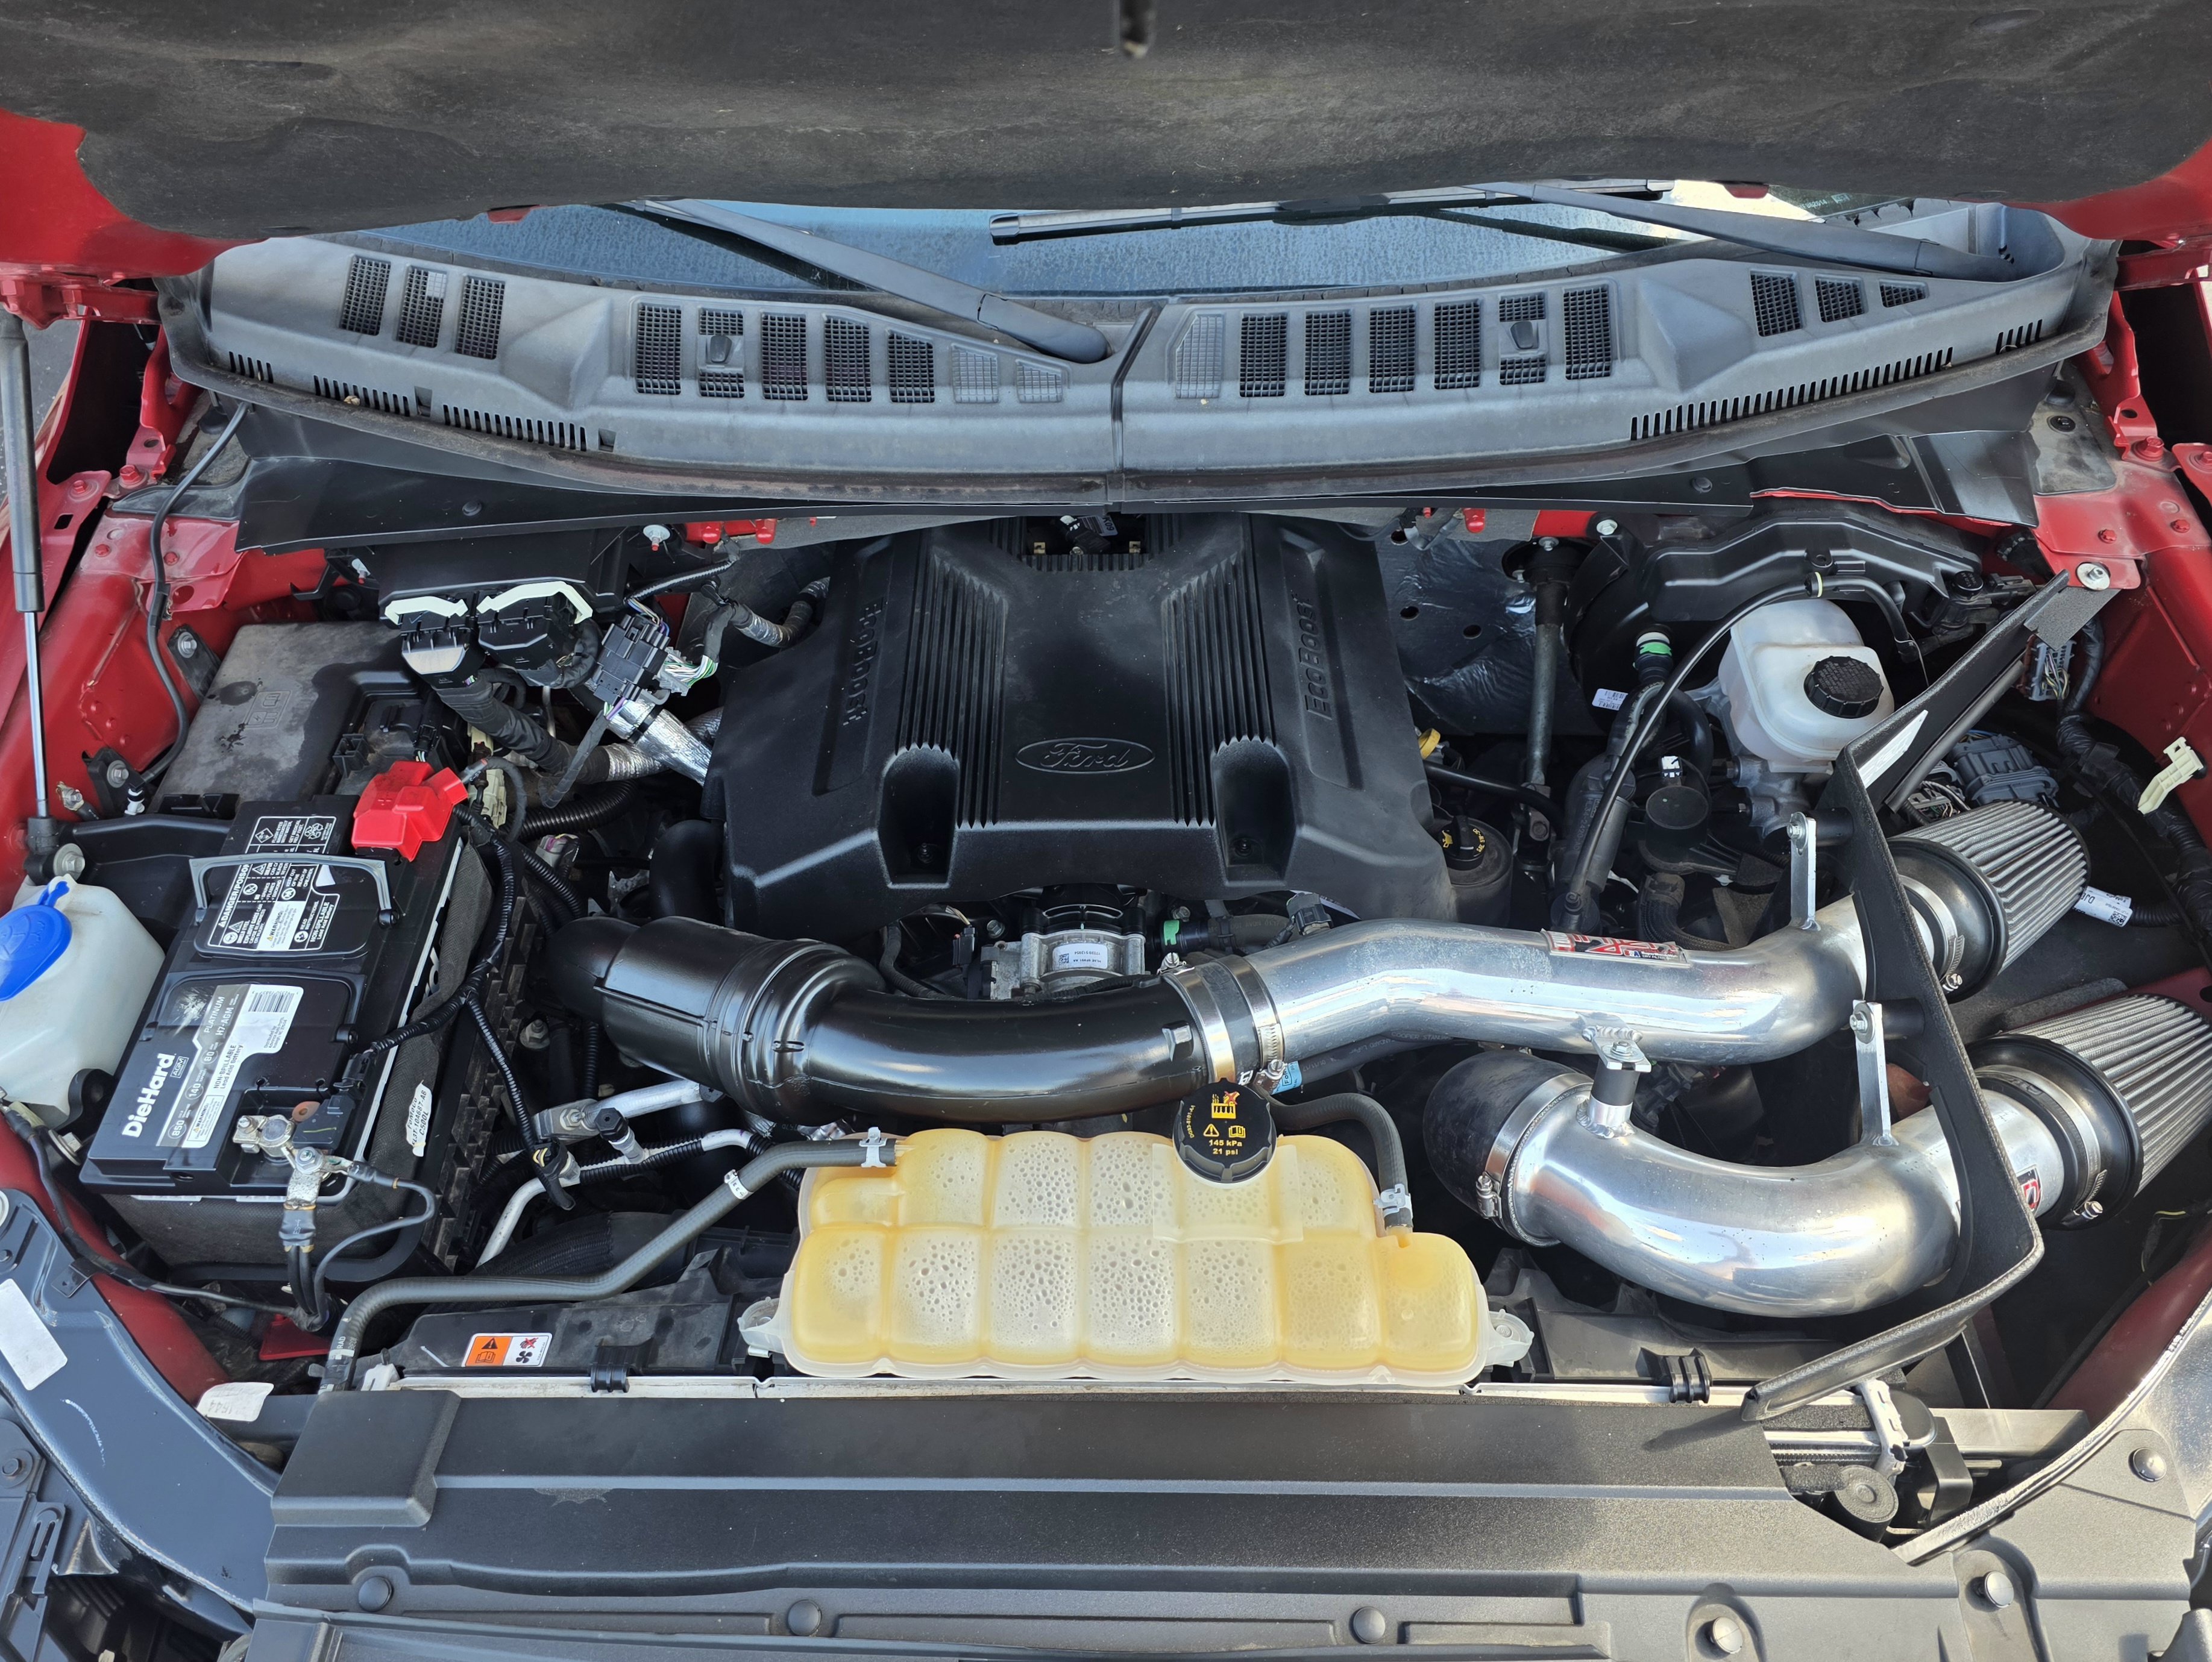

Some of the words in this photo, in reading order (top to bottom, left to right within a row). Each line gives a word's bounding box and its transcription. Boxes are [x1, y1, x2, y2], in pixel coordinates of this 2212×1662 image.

[203, 997, 225, 1033] PLATINUM
[214, 1006, 234, 1035] H7-AGM
[203, 1052, 215, 1061] 80
[229, 1045, 244, 1063] Battery
[172, 1057, 184, 1076] AGM
[212, 1044, 237, 1088] NON-SPILLABLE
[122, 1053, 175, 1138] DieHard
[187, 1083, 202, 1097] 140
[171, 1120, 186, 1136] 850
[419, 1111, 429, 1135] C500L
